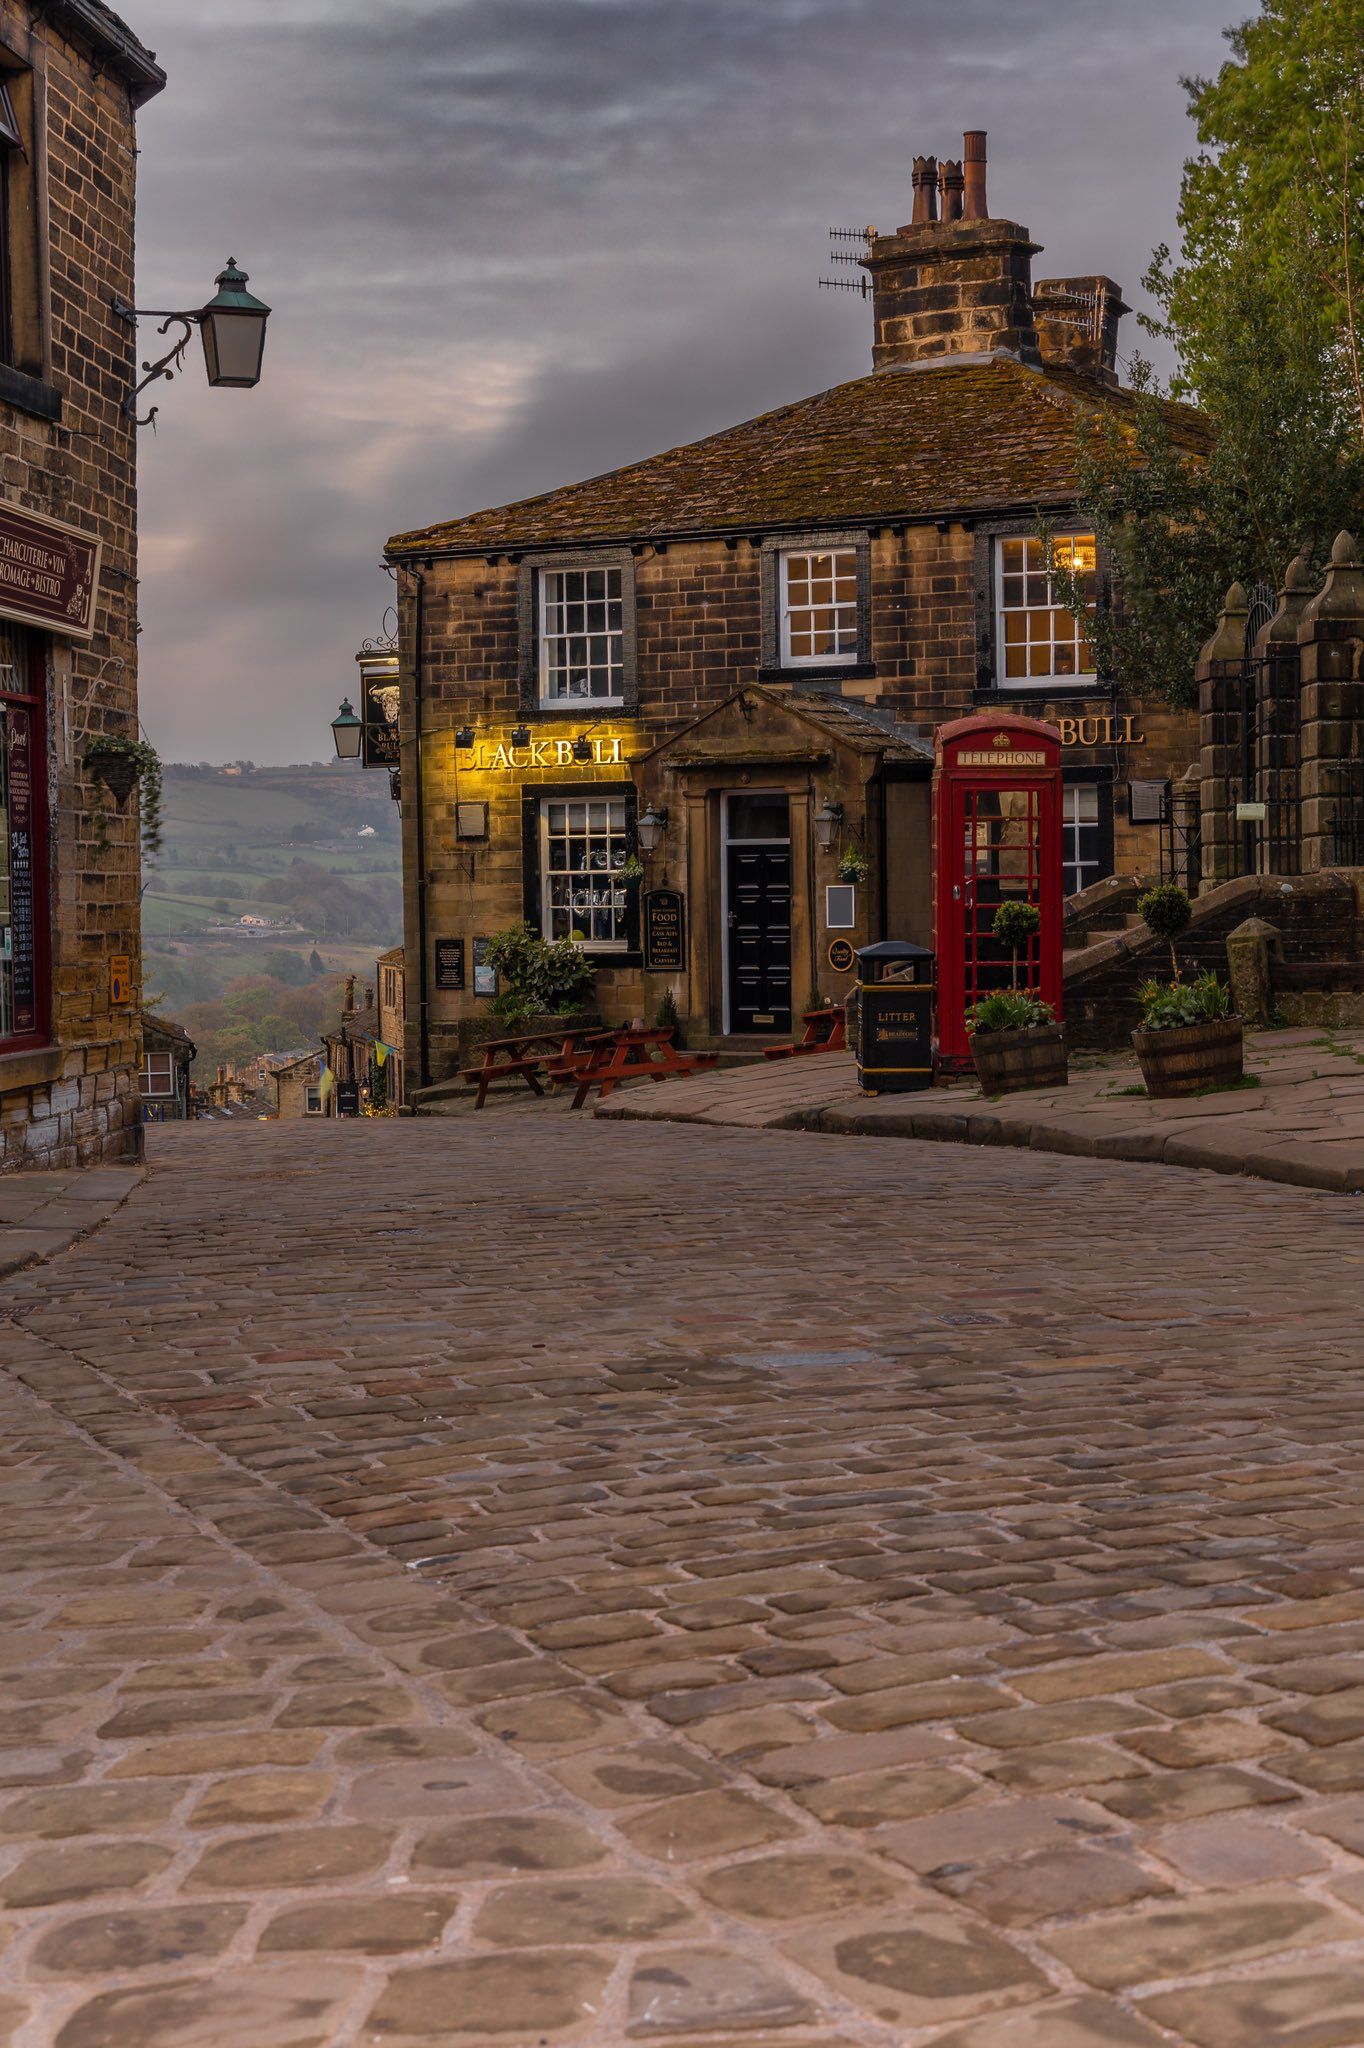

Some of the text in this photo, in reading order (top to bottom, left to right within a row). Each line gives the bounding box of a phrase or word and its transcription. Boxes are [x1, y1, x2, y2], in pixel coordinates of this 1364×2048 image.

[0, 536, 66, 575] CHARCUTERIE VIN
[0, 562, 61, 597] ROMAGE BISTRO
[1057, 716, 1144, 746] BULL
[459, 738, 628, 770] BLACK BLL
[962, 752, 1044, 765] TELEPHONE
[652, 912, 677, 922] FOOD
[878, 1012, 917, 1022] LITTER
